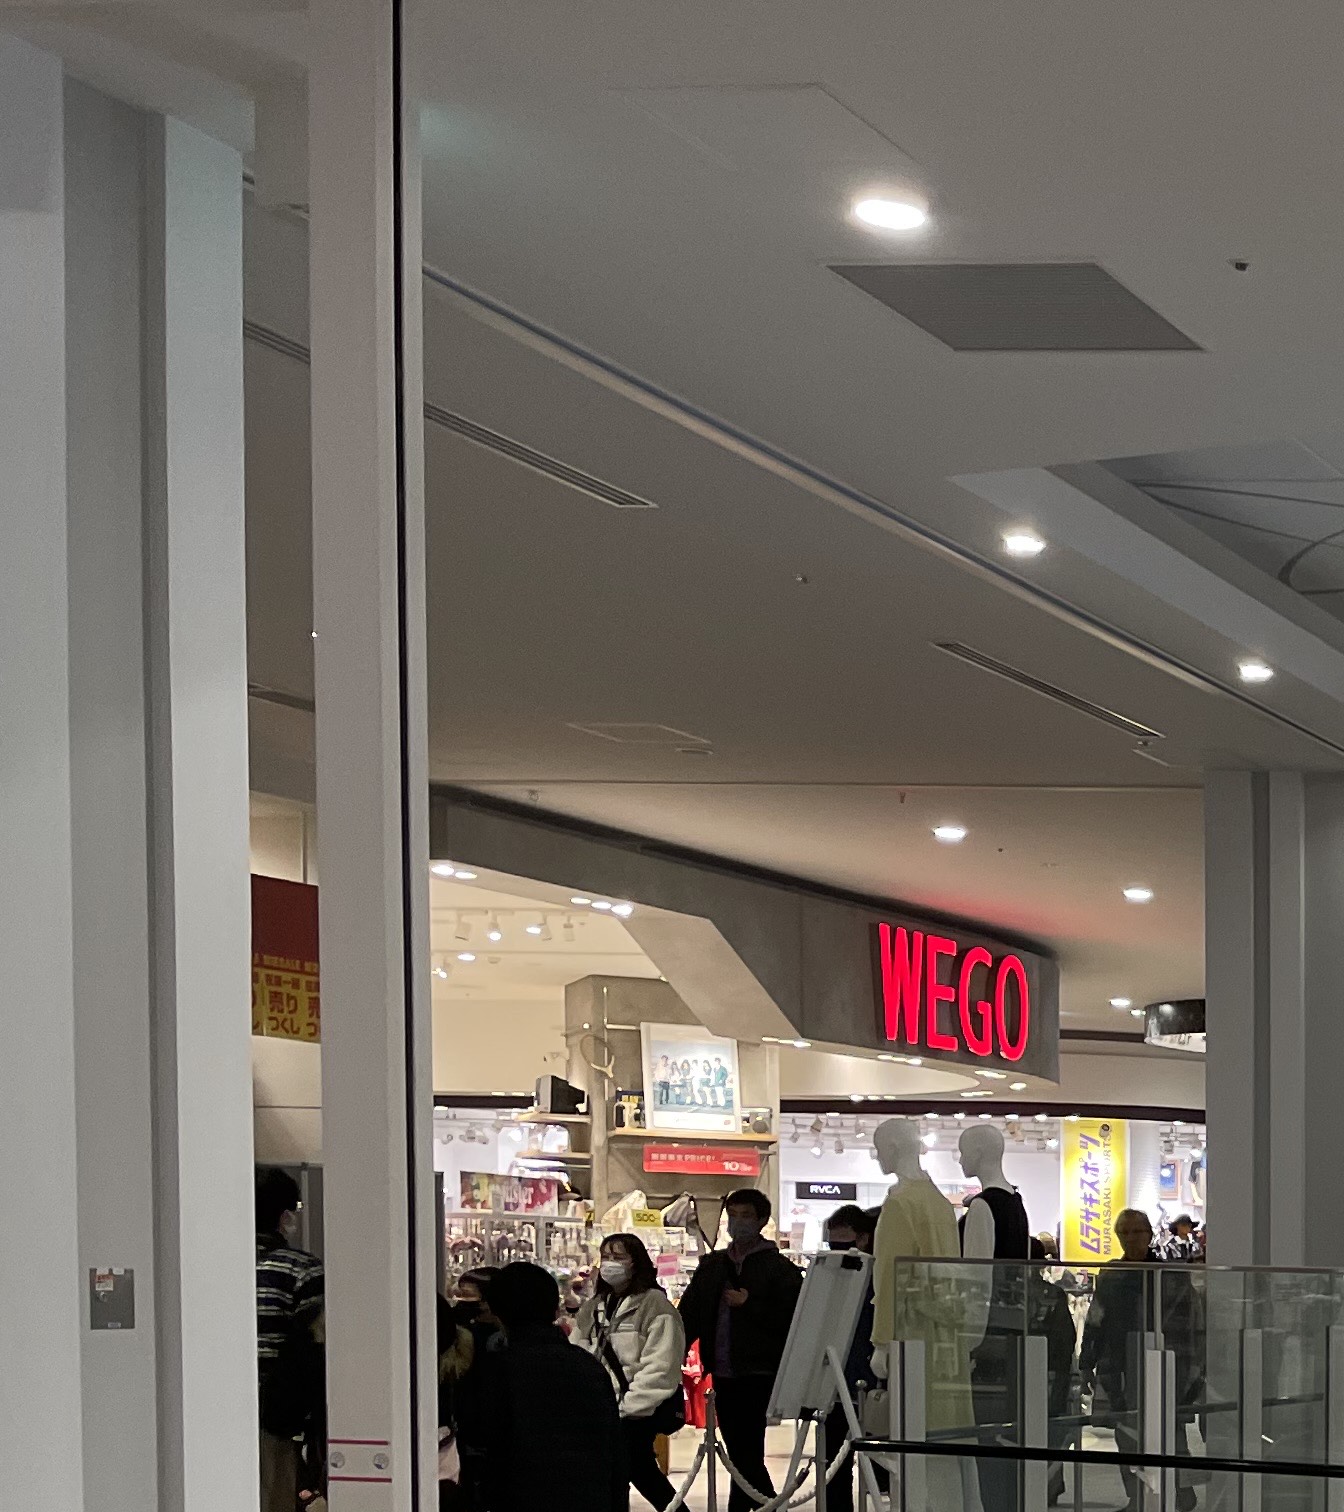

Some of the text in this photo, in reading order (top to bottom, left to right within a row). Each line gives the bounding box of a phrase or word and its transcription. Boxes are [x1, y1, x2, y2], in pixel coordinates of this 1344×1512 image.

[267, 1015, 300, 1035] つくし
[879, 922, 1029, 1061] WEGO
[809, 1184, 841, 1194] RVCA
[1079, 1132, 1101, 1255] ムラサキスポーツ
[1103, 1186, 1112, 1255] MURASAKI
